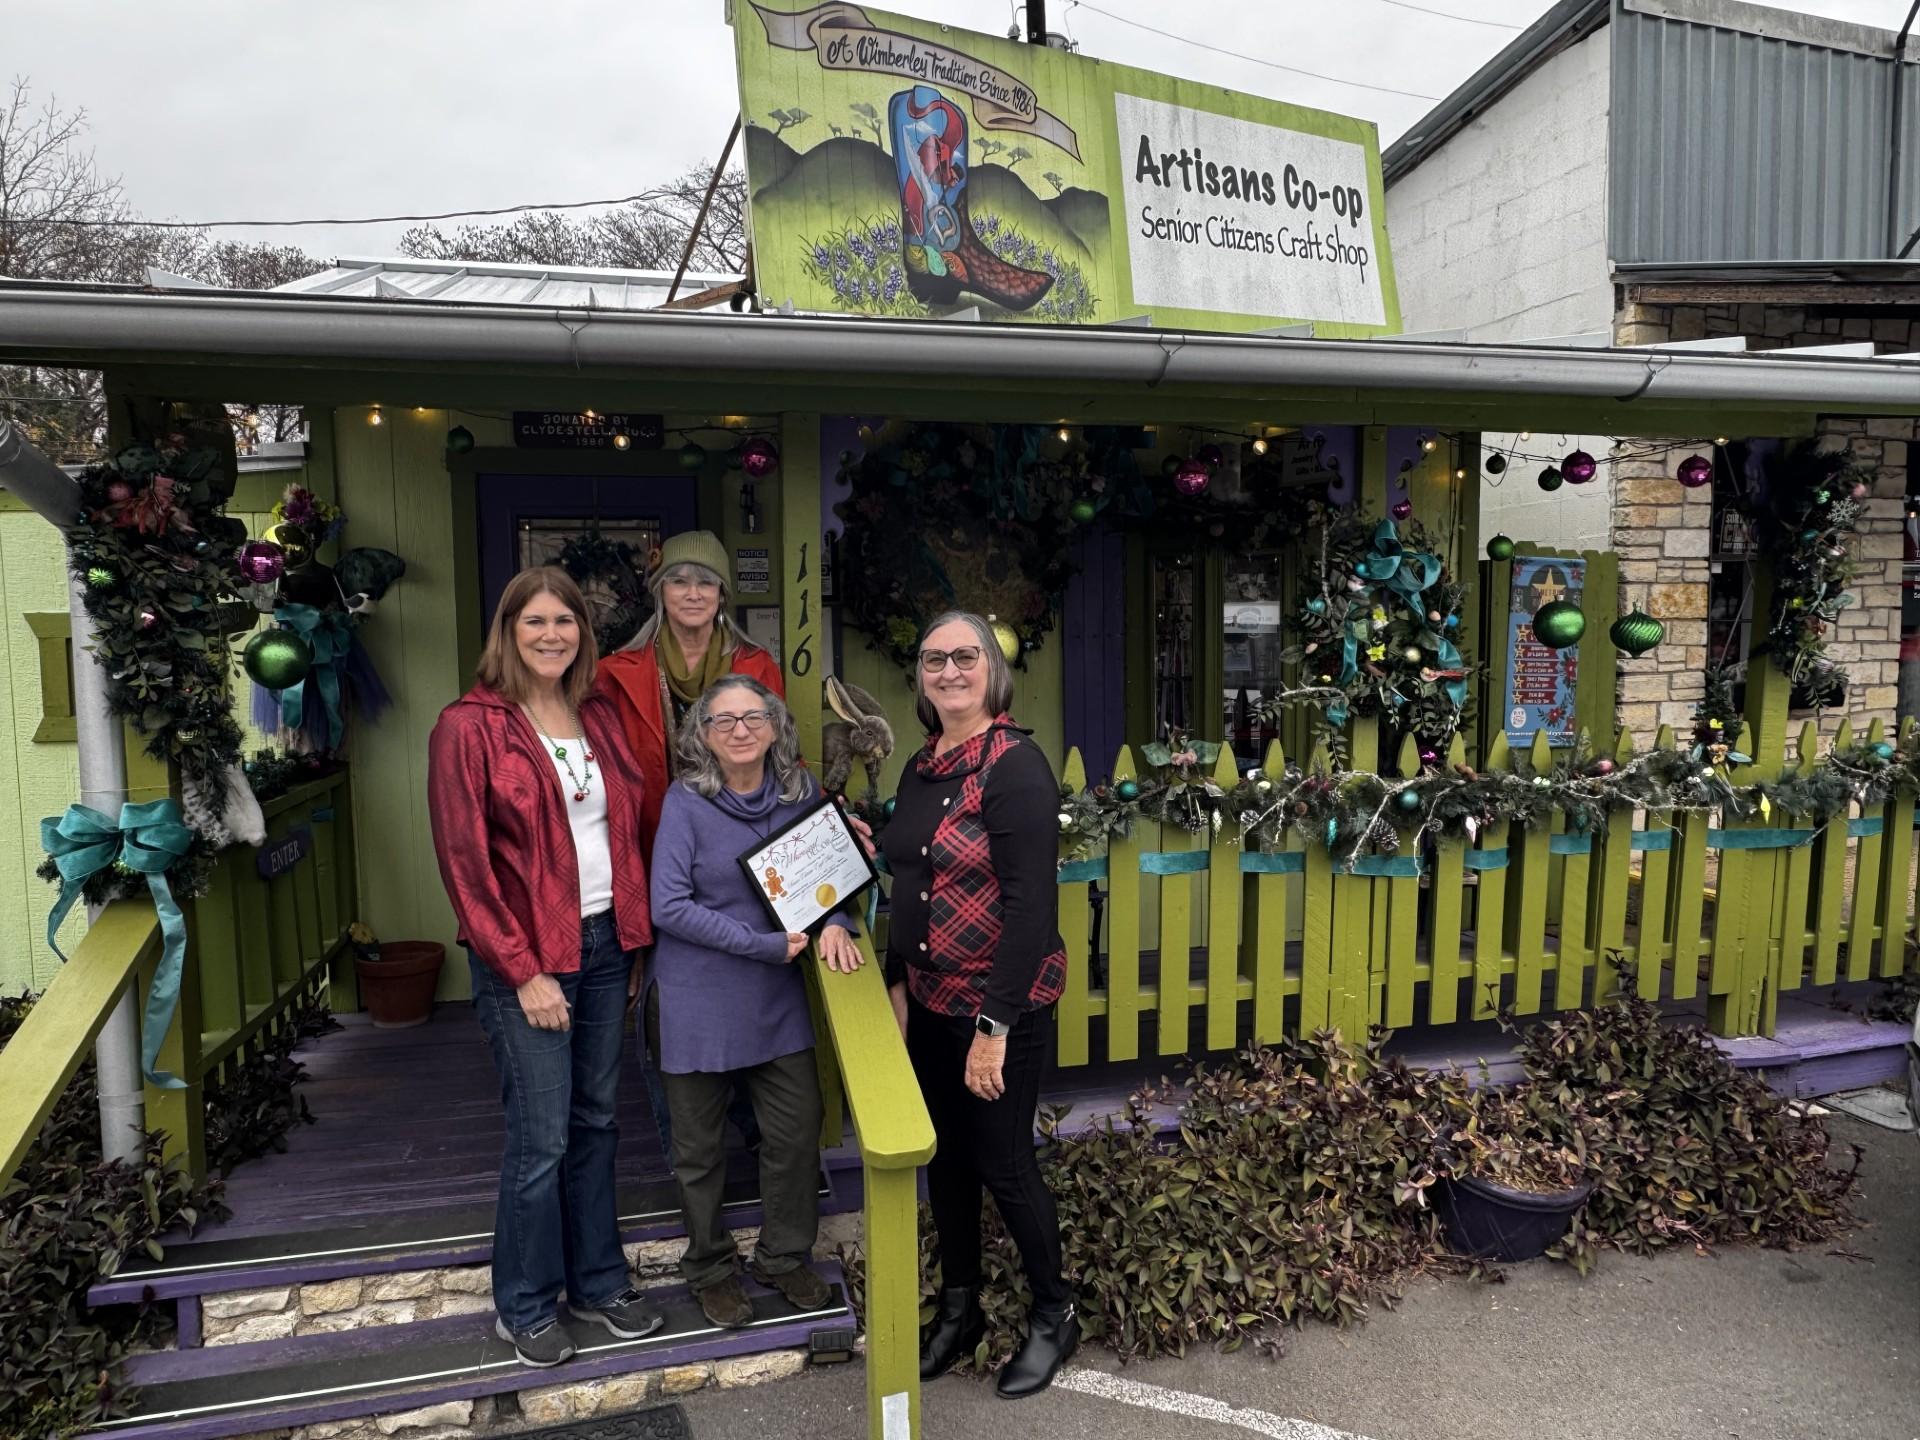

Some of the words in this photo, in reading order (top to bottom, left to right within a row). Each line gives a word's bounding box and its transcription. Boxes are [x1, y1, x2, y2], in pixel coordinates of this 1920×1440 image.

[827, 34, 853, 64] A
[856, 35, 927, 78] Wimberley
[925, 51, 978, 88] Tradition
[979, 71, 1010, 103] Since
[1136, 134, 1276, 206] Artisans
[1283, 163, 1363, 228] Co-op
[1141, 206, 1202, 244] Senior
[1206, 215, 1274, 254] Citizens
[1278, 220, 1324, 261] Craft
[1326, 224, 1368, 284] Shop
[613, 415, 629, 426] BY
[740, 572, 768, 580] AVISO
[270, 840, 300, 873] ENTER
